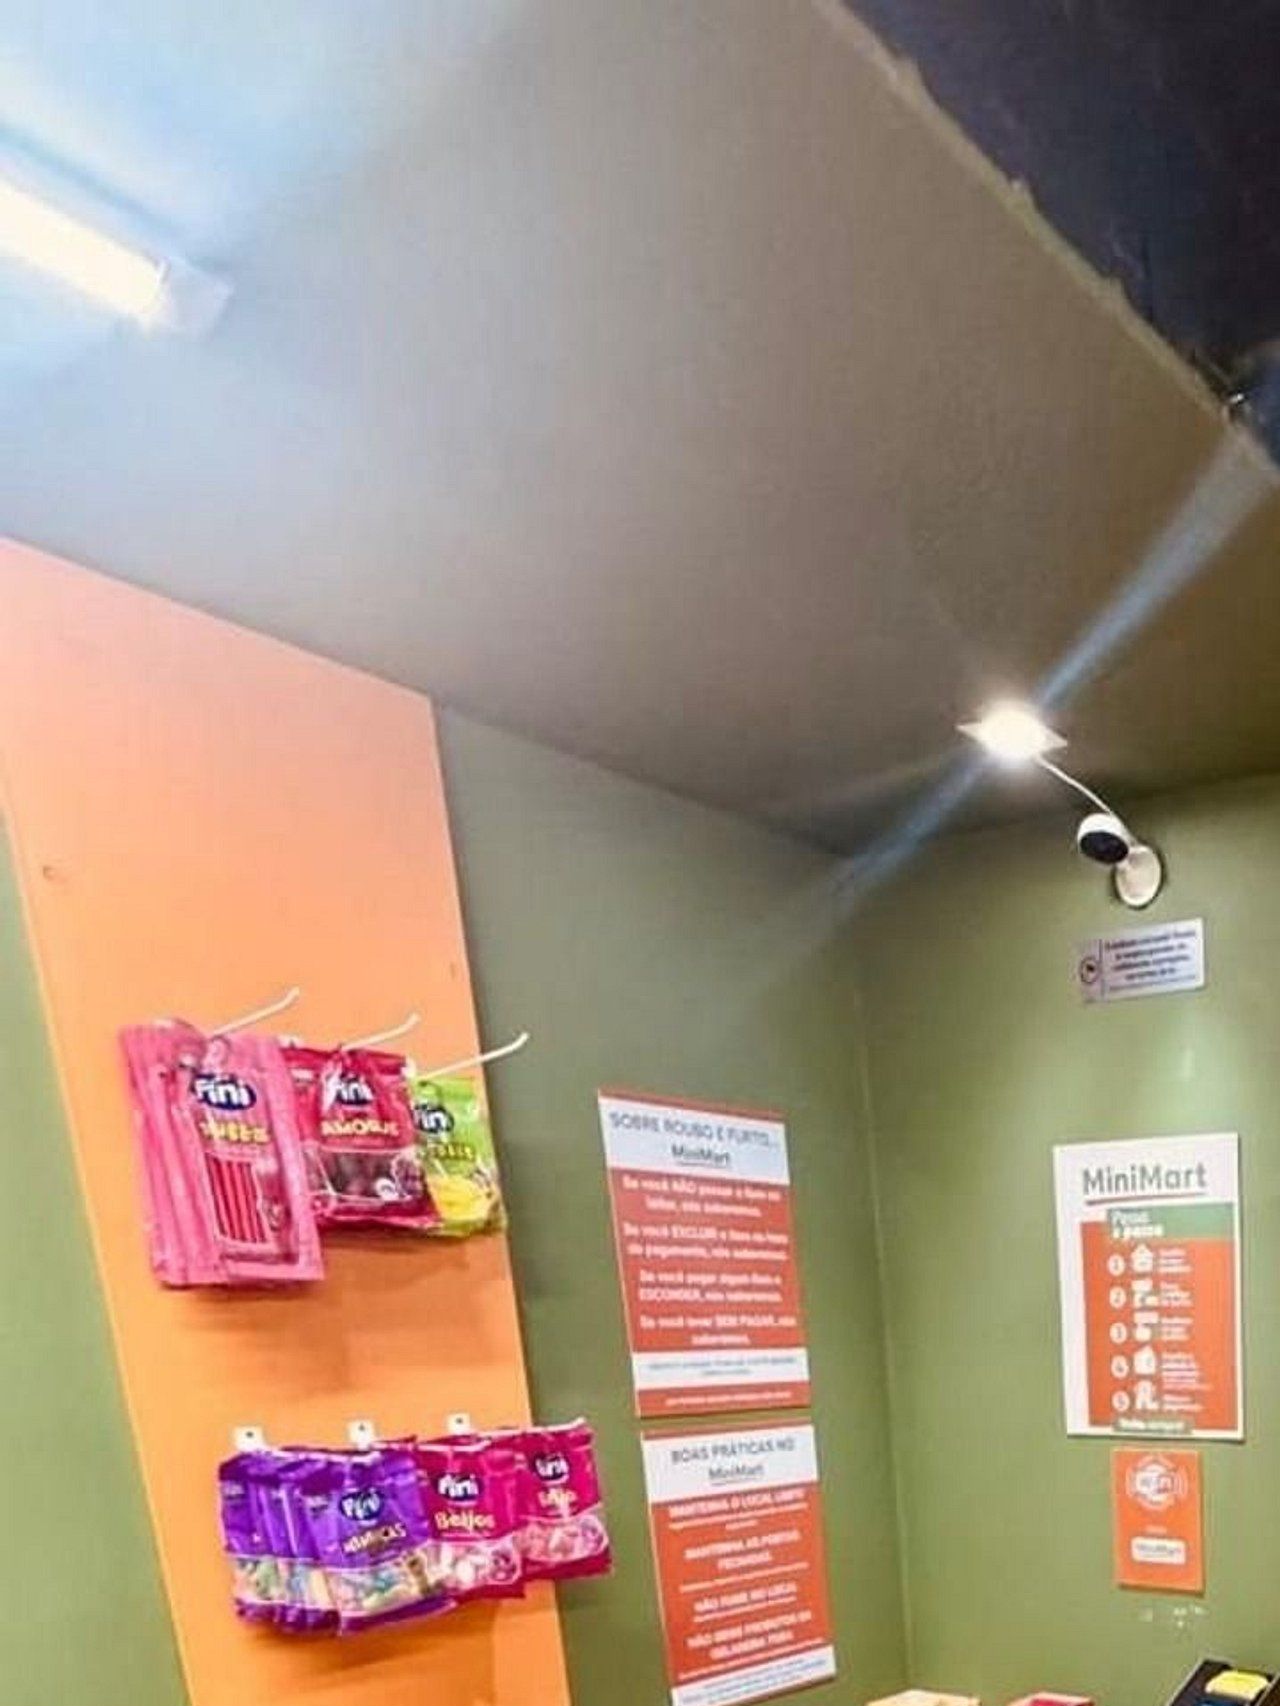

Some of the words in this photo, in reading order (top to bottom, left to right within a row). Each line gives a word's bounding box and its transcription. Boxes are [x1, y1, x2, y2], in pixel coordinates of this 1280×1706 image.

[609, 1111, 660, 1132] SOBRE
[664, 1119, 713, 1140] ROUBO
[1083, 1162, 1207, 1196] MiniMart
[672, 1447, 709, 1465] BOAS
[711, 1438, 774, 1458] PRÁTICAS
[776, 1436, 796, 1451] NO
